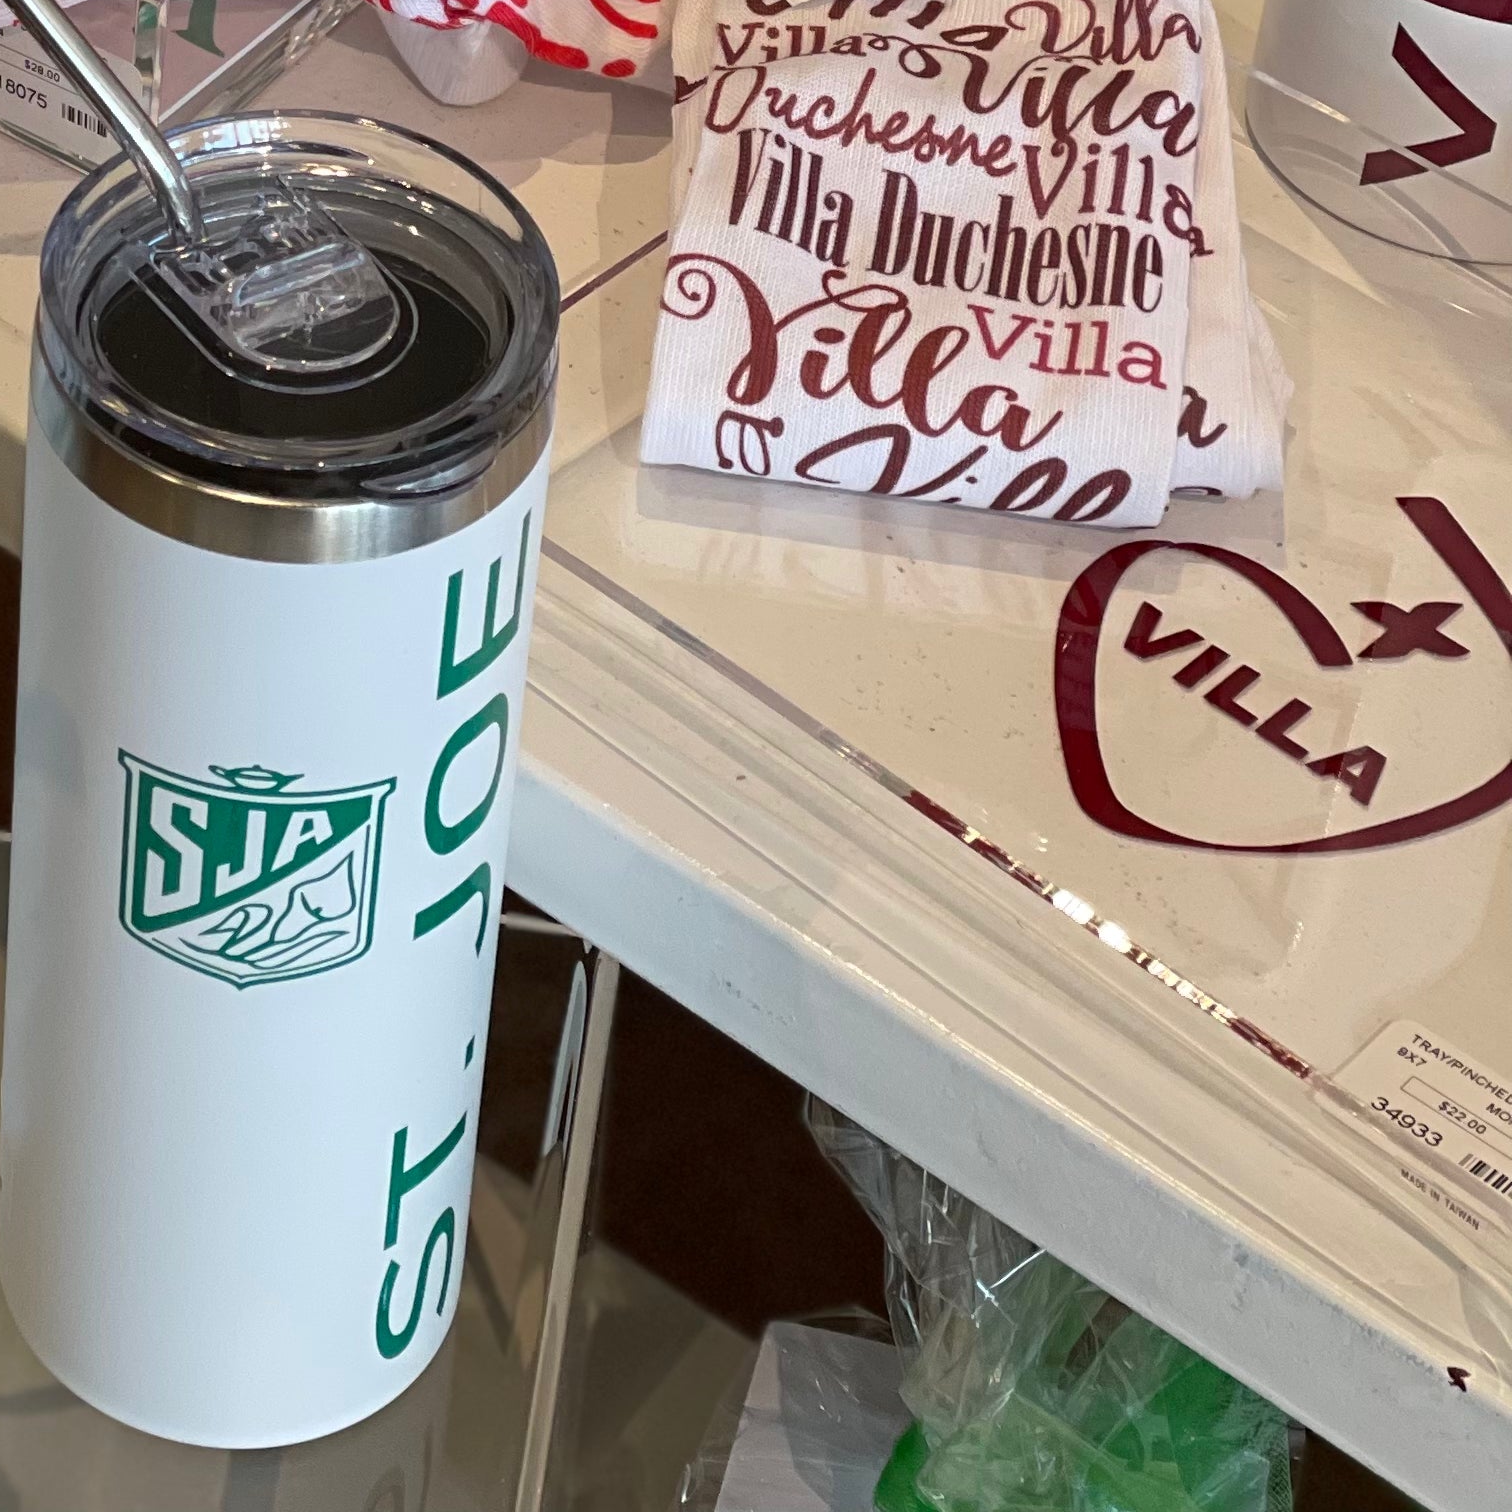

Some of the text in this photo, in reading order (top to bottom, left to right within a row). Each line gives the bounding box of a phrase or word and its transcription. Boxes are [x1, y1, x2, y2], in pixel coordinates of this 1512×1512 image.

[23, 59, 61, 83] $28.00
[715, 22, 865, 66] Villa
[726, 127, 1166, 313] Villa Duchesne
[660, 253, 1063, 452] Villa
[966, 303, 1167, 390] Villa
[1123, 600, 1388, 807] VILLA
[142, 784, 331, 922] SJA
[374, 506, 532, 1361] ST. JOE
[1370, 1095, 1444, 1148] 34933
[1438, 1100, 1487, 1135] $22.00
[1485, 1102, 1512, 1126] MO
[1400, 1167, 1480, 1230] MADE IN TAIWAN
